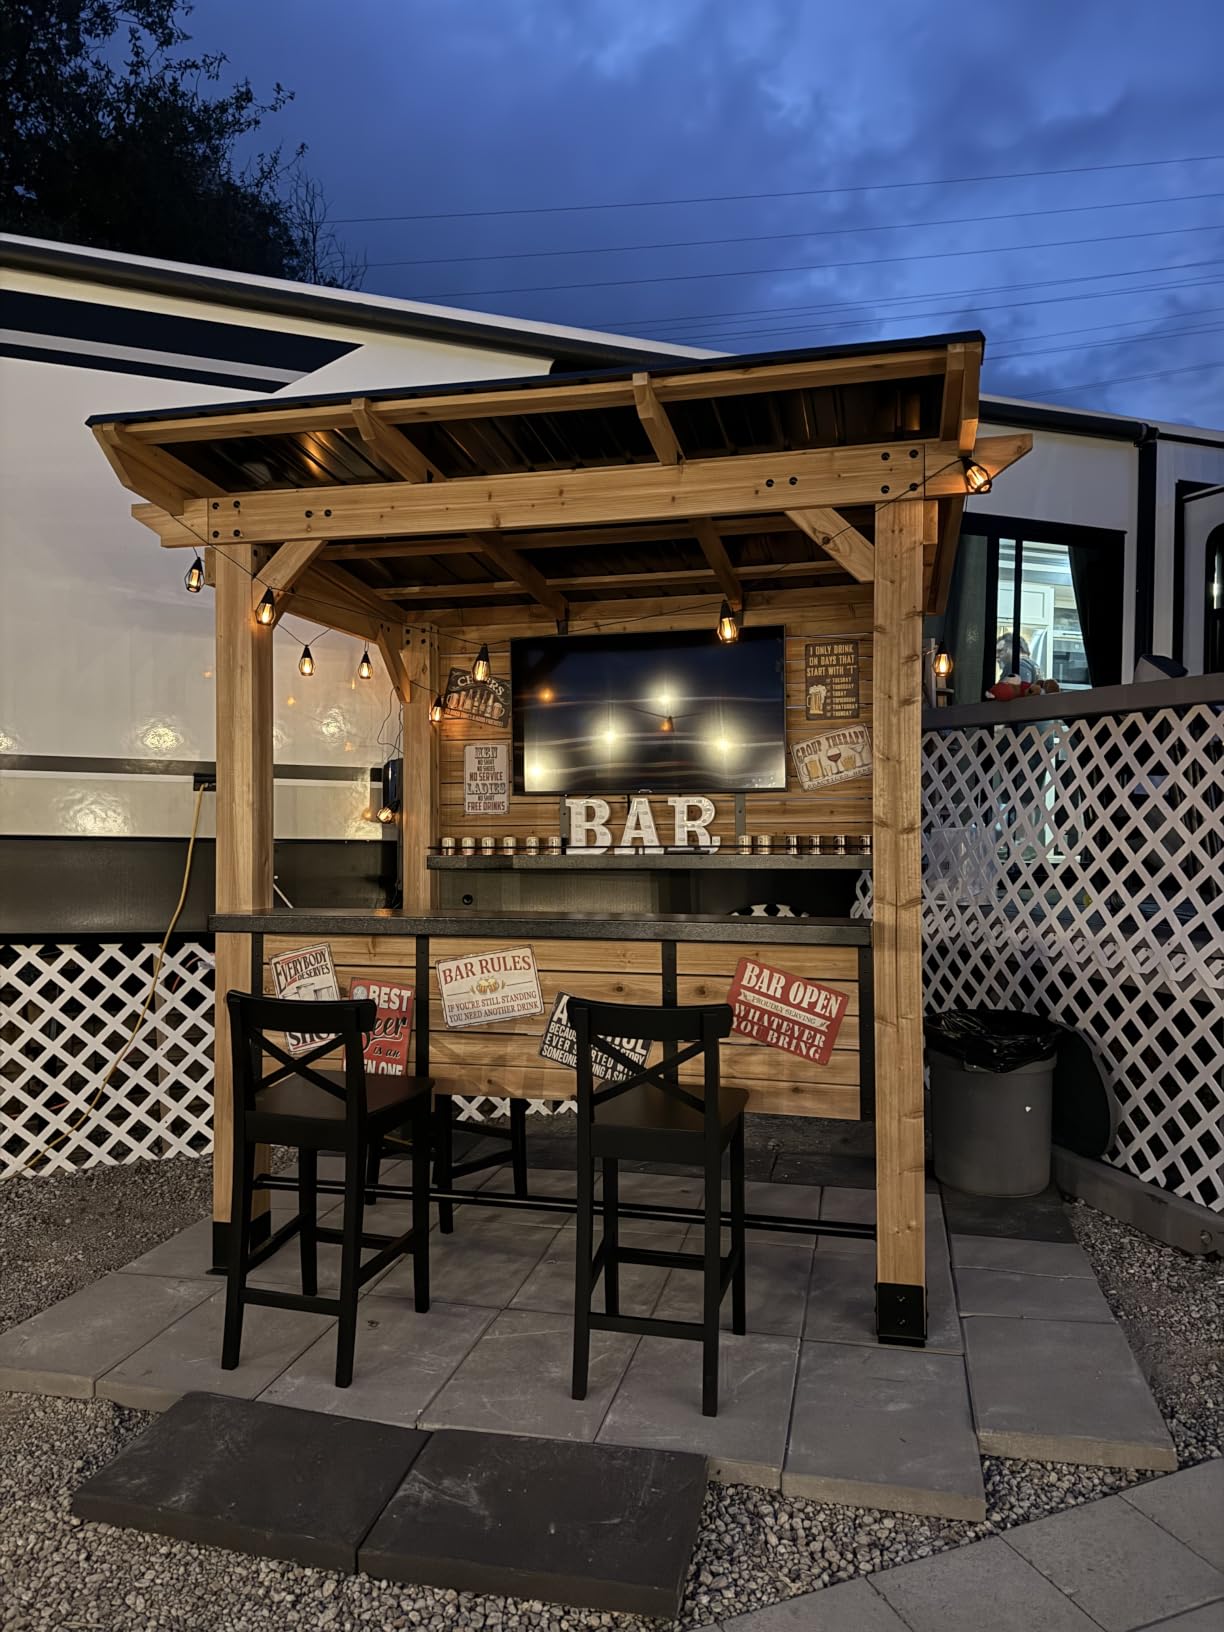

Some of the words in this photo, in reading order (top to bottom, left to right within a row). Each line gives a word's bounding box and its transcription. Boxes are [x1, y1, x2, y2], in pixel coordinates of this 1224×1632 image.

[809, 656, 818, 666] ON
[820, 655, 837, 665] DAYS
[838, 654, 855, 664] THAT
[815, 645, 832, 655] ONLY
[833, 644, 854, 653] DRINK
[806, 667, 826, 677] START
[827, 665, 844, 675] WITH
[795, 740, 822, 760] GROUP
[825, 730, 864, 748] THERAPY
[469, 771, 478, 781] NO
[479, 771, 504, 781] SERVICE
[466, 782, 506, 795] LADIES
[467, 801, 482, 811] FREE
[482, 801, 506, 811] DRINKS
[565, 797, 721, 855] BAR
[273, 949, 327, 994] EVERYBODY
[297, 963, 331, 981] DESERVES
[442, 961, 477, 985] BAR
[478, 955, 532, 975] RULES
[447, 1004, 456, 1013] IF
[455, 999, 481, 1012] YOU'RE
[481, 996, 501, 1007] STILL
[501, 990, 537, 1004] STANDING
[741, 962, 786, 998] BAR
[788, 981, 843, 1019] OPEN
[448, 1013, 464, 1024] YOU
[464, 1010, 482, 1021] NEED
[483, 1004, 516, 1017] ANOTHER
[516, 1001, 539, 1012] DRINK
[750, 994, 784, 1013] PROUDLY
[784, 1007, 817, 1025] SERVING
[735, 1003, 826, 1048] WHATEVER
[545, 1033, 571, 1052] EVER
[731, 1016, 763, 1037] YOU
[766, 1029, 821, 1060] BRING
[372, 1044, 383, 1056] is
[385, 1048, 401, 1058] an
